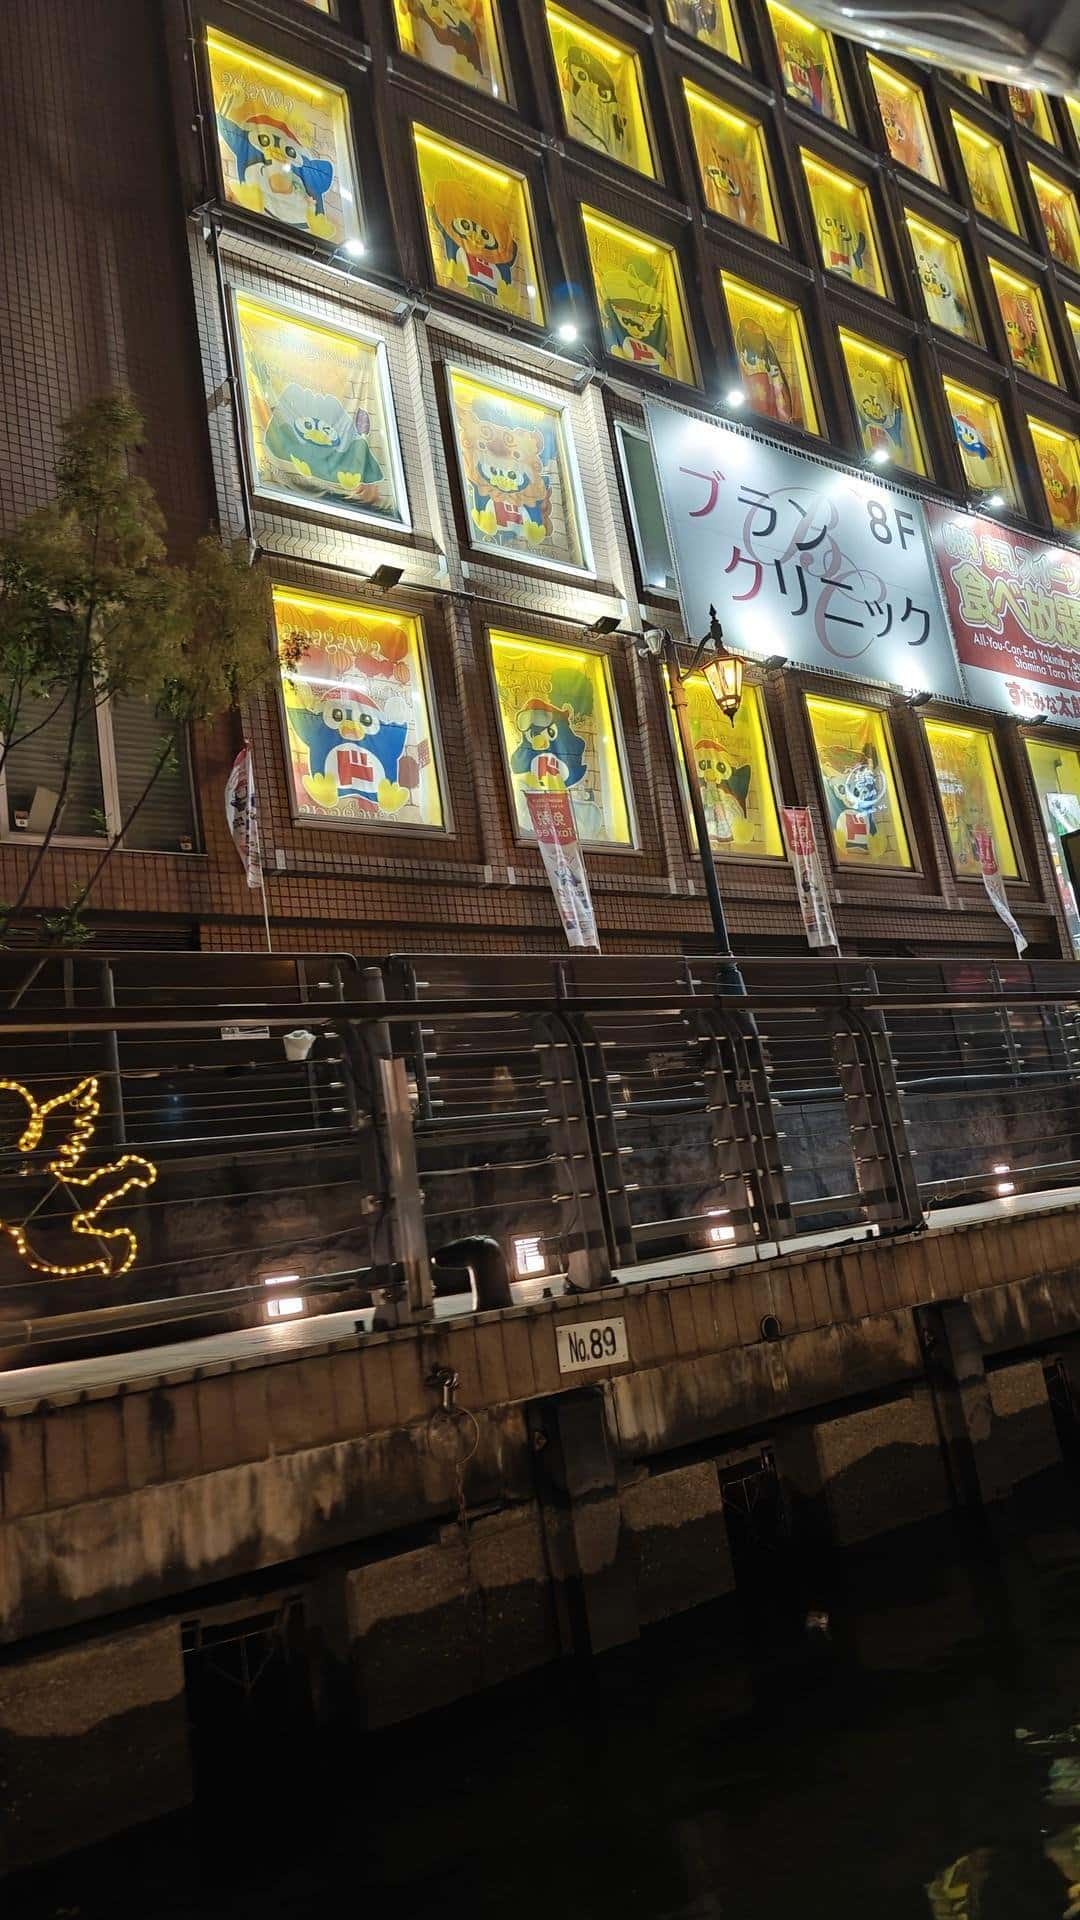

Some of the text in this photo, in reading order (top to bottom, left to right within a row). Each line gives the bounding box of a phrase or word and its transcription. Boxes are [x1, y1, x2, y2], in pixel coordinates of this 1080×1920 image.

[680, 466, 827, 551] ブラン
[867, 500, 915, 550] 8F
[724, 546, 930, 646] クリニック
[973, 632, 1038, 660] All-You-Can-Eat
[1014, 656, 1047, 677] Stamina
[568, 1326, 617, 1363] No.89
